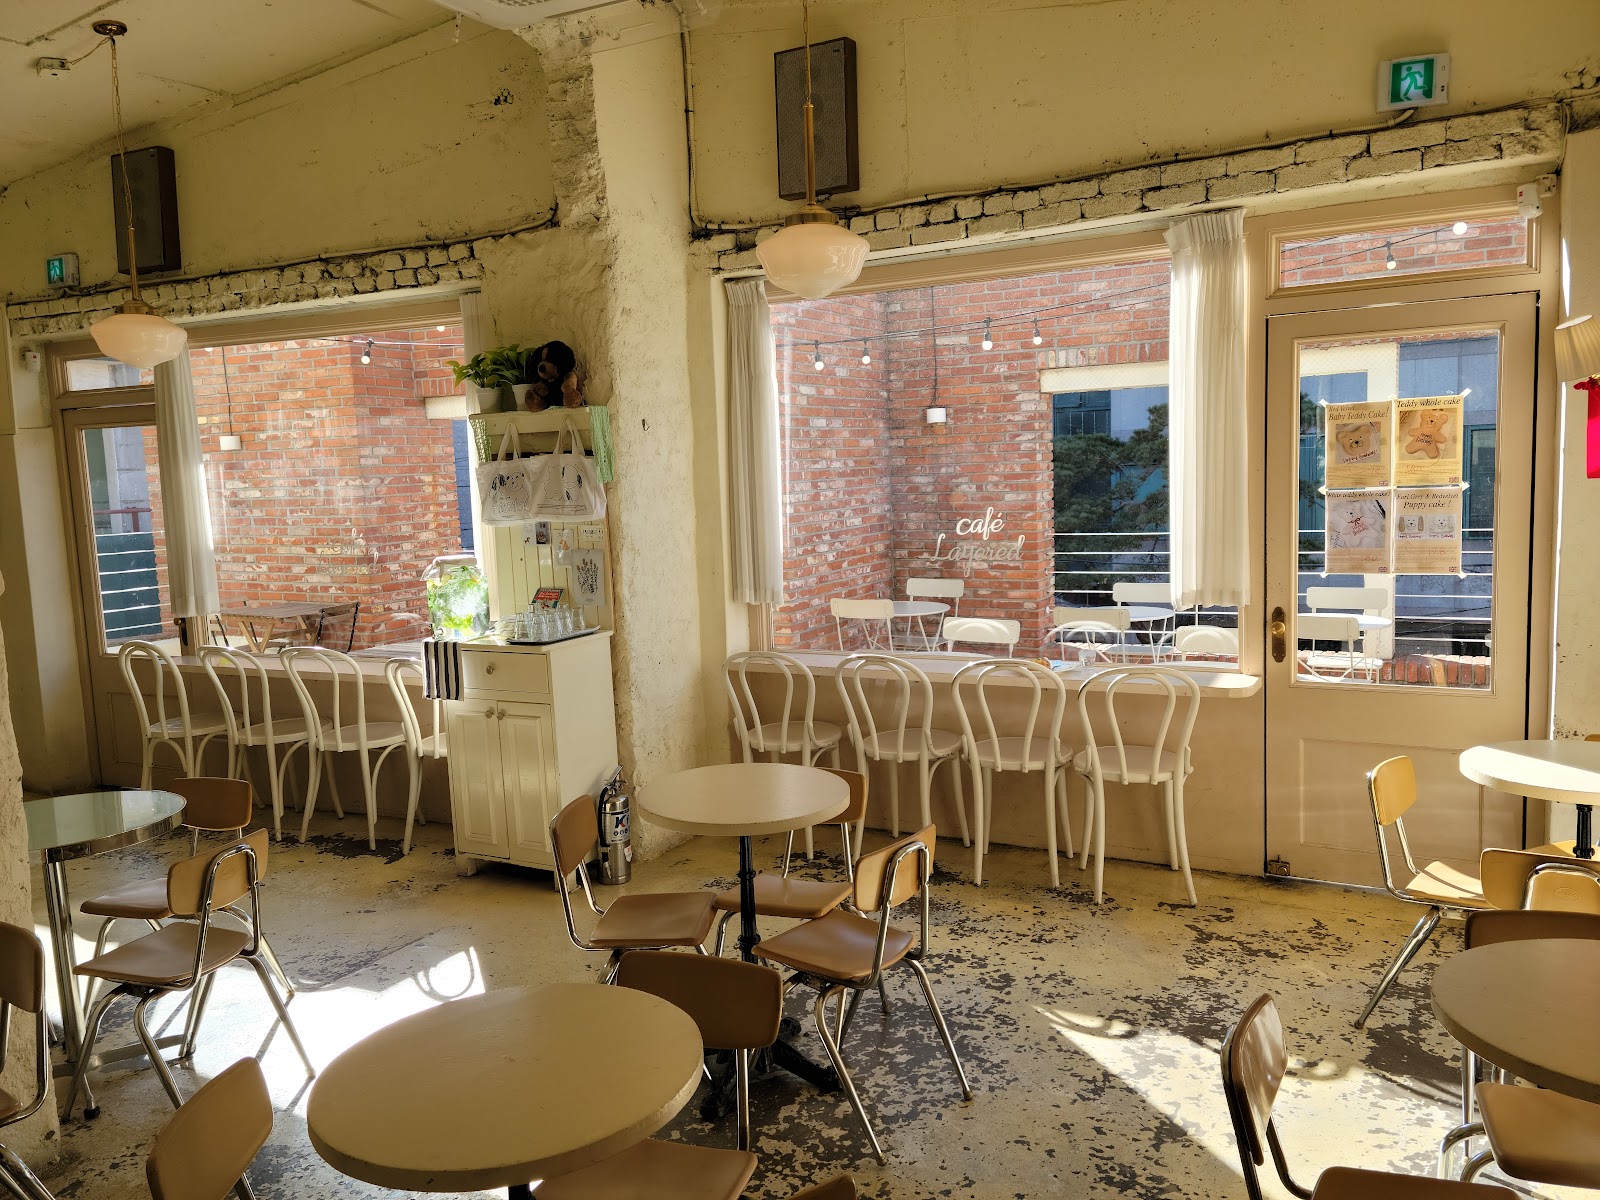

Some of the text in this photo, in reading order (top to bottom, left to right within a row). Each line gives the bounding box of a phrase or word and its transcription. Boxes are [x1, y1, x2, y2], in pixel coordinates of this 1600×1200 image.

[1396, 397, 1461, 409] Teddy whole cake
[1328, 406, 1390, 422] Baby Teddy Cake!
[1403, 501, 1426, 510] Puppy
[1428, 500, 1446, 508] cake
[956, 506, 1005, 541] café
[930, 533, 1026, 578] Layered
